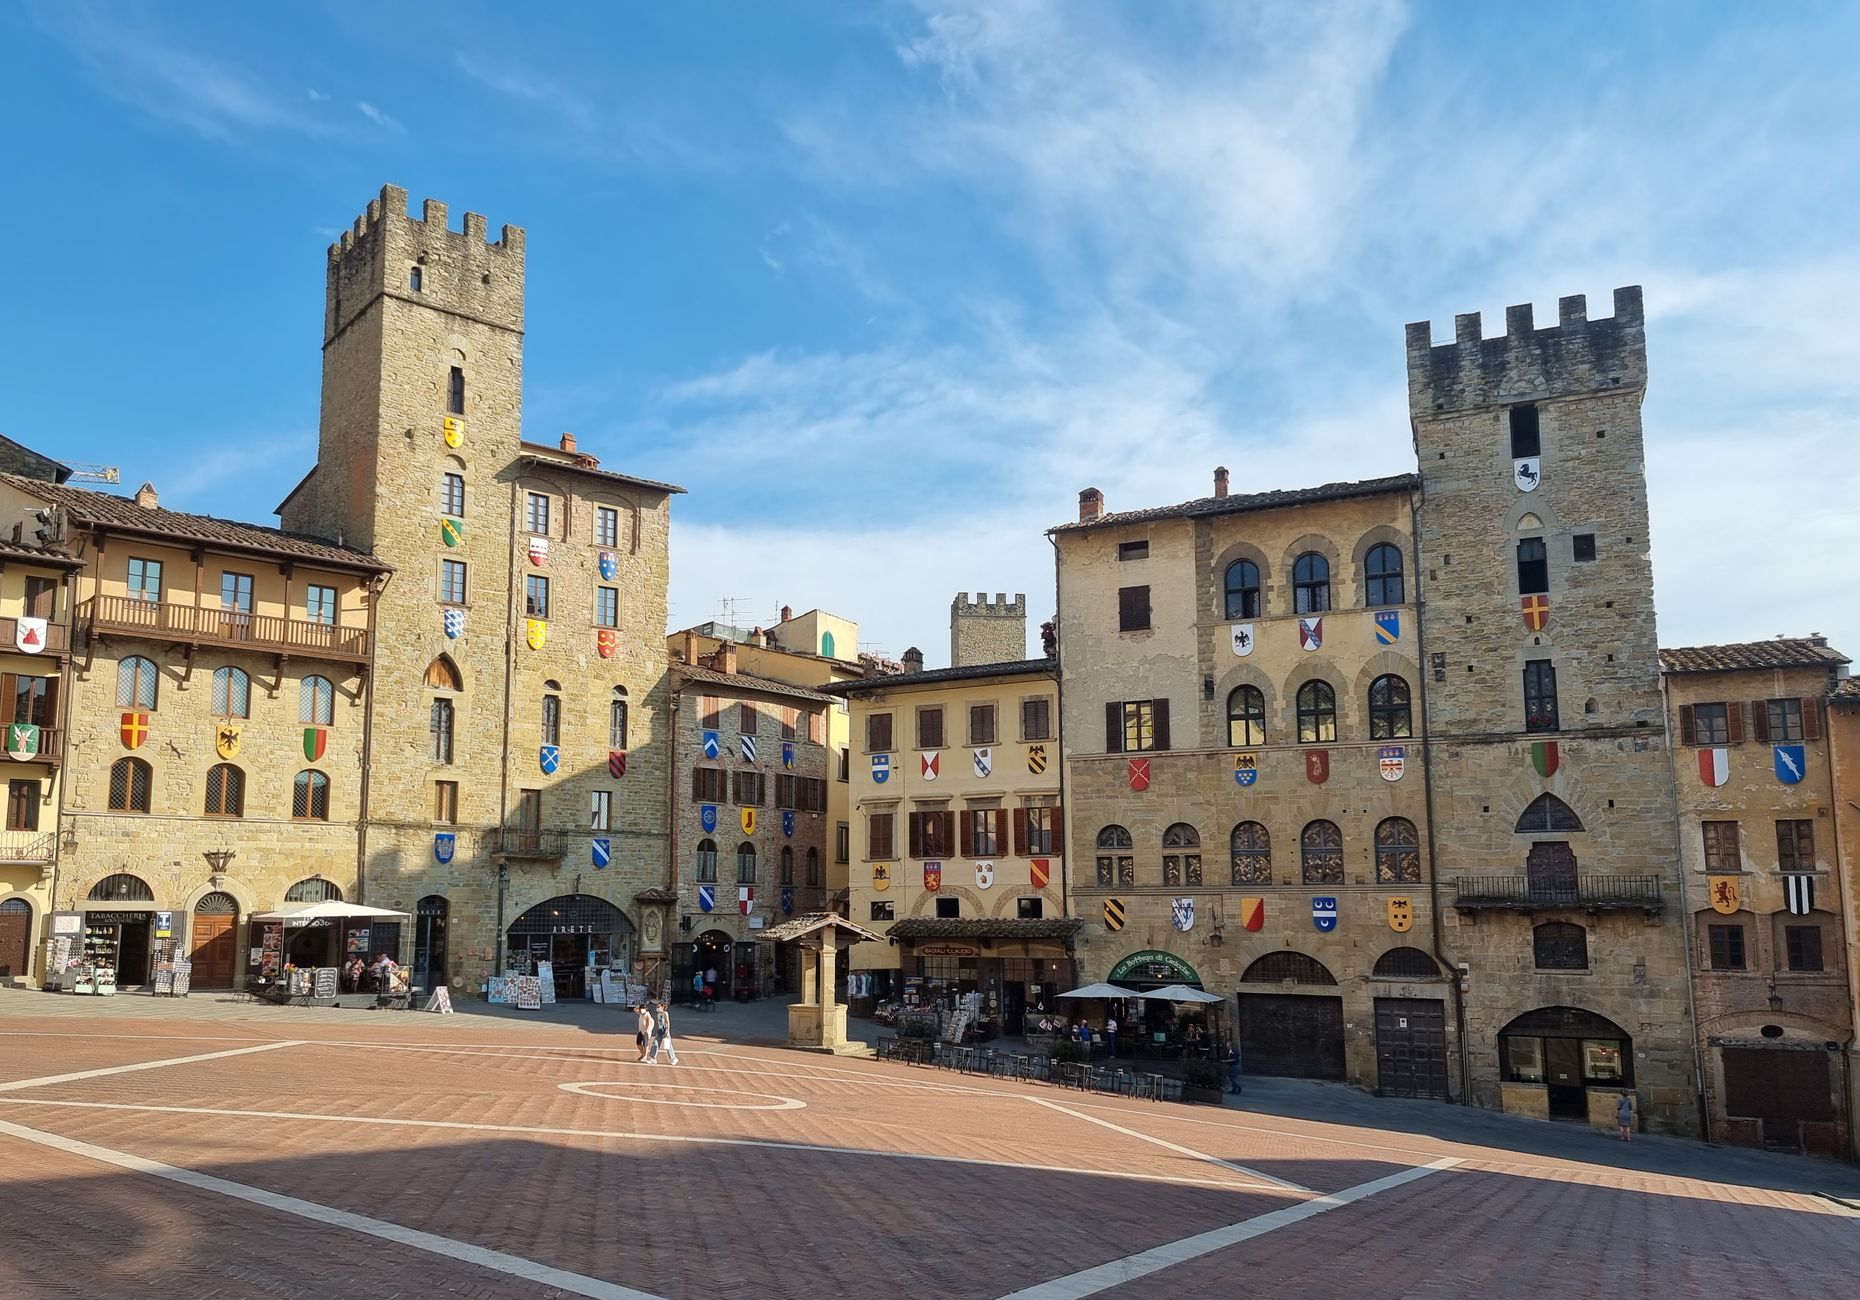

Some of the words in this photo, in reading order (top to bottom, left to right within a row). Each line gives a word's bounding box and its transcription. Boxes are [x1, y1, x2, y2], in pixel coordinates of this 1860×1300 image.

[90, 912, 147, 920] TABACCHERIA
[1117, 966, 1127, 974] La
[1126, 954, 1154, 967] Bottega
